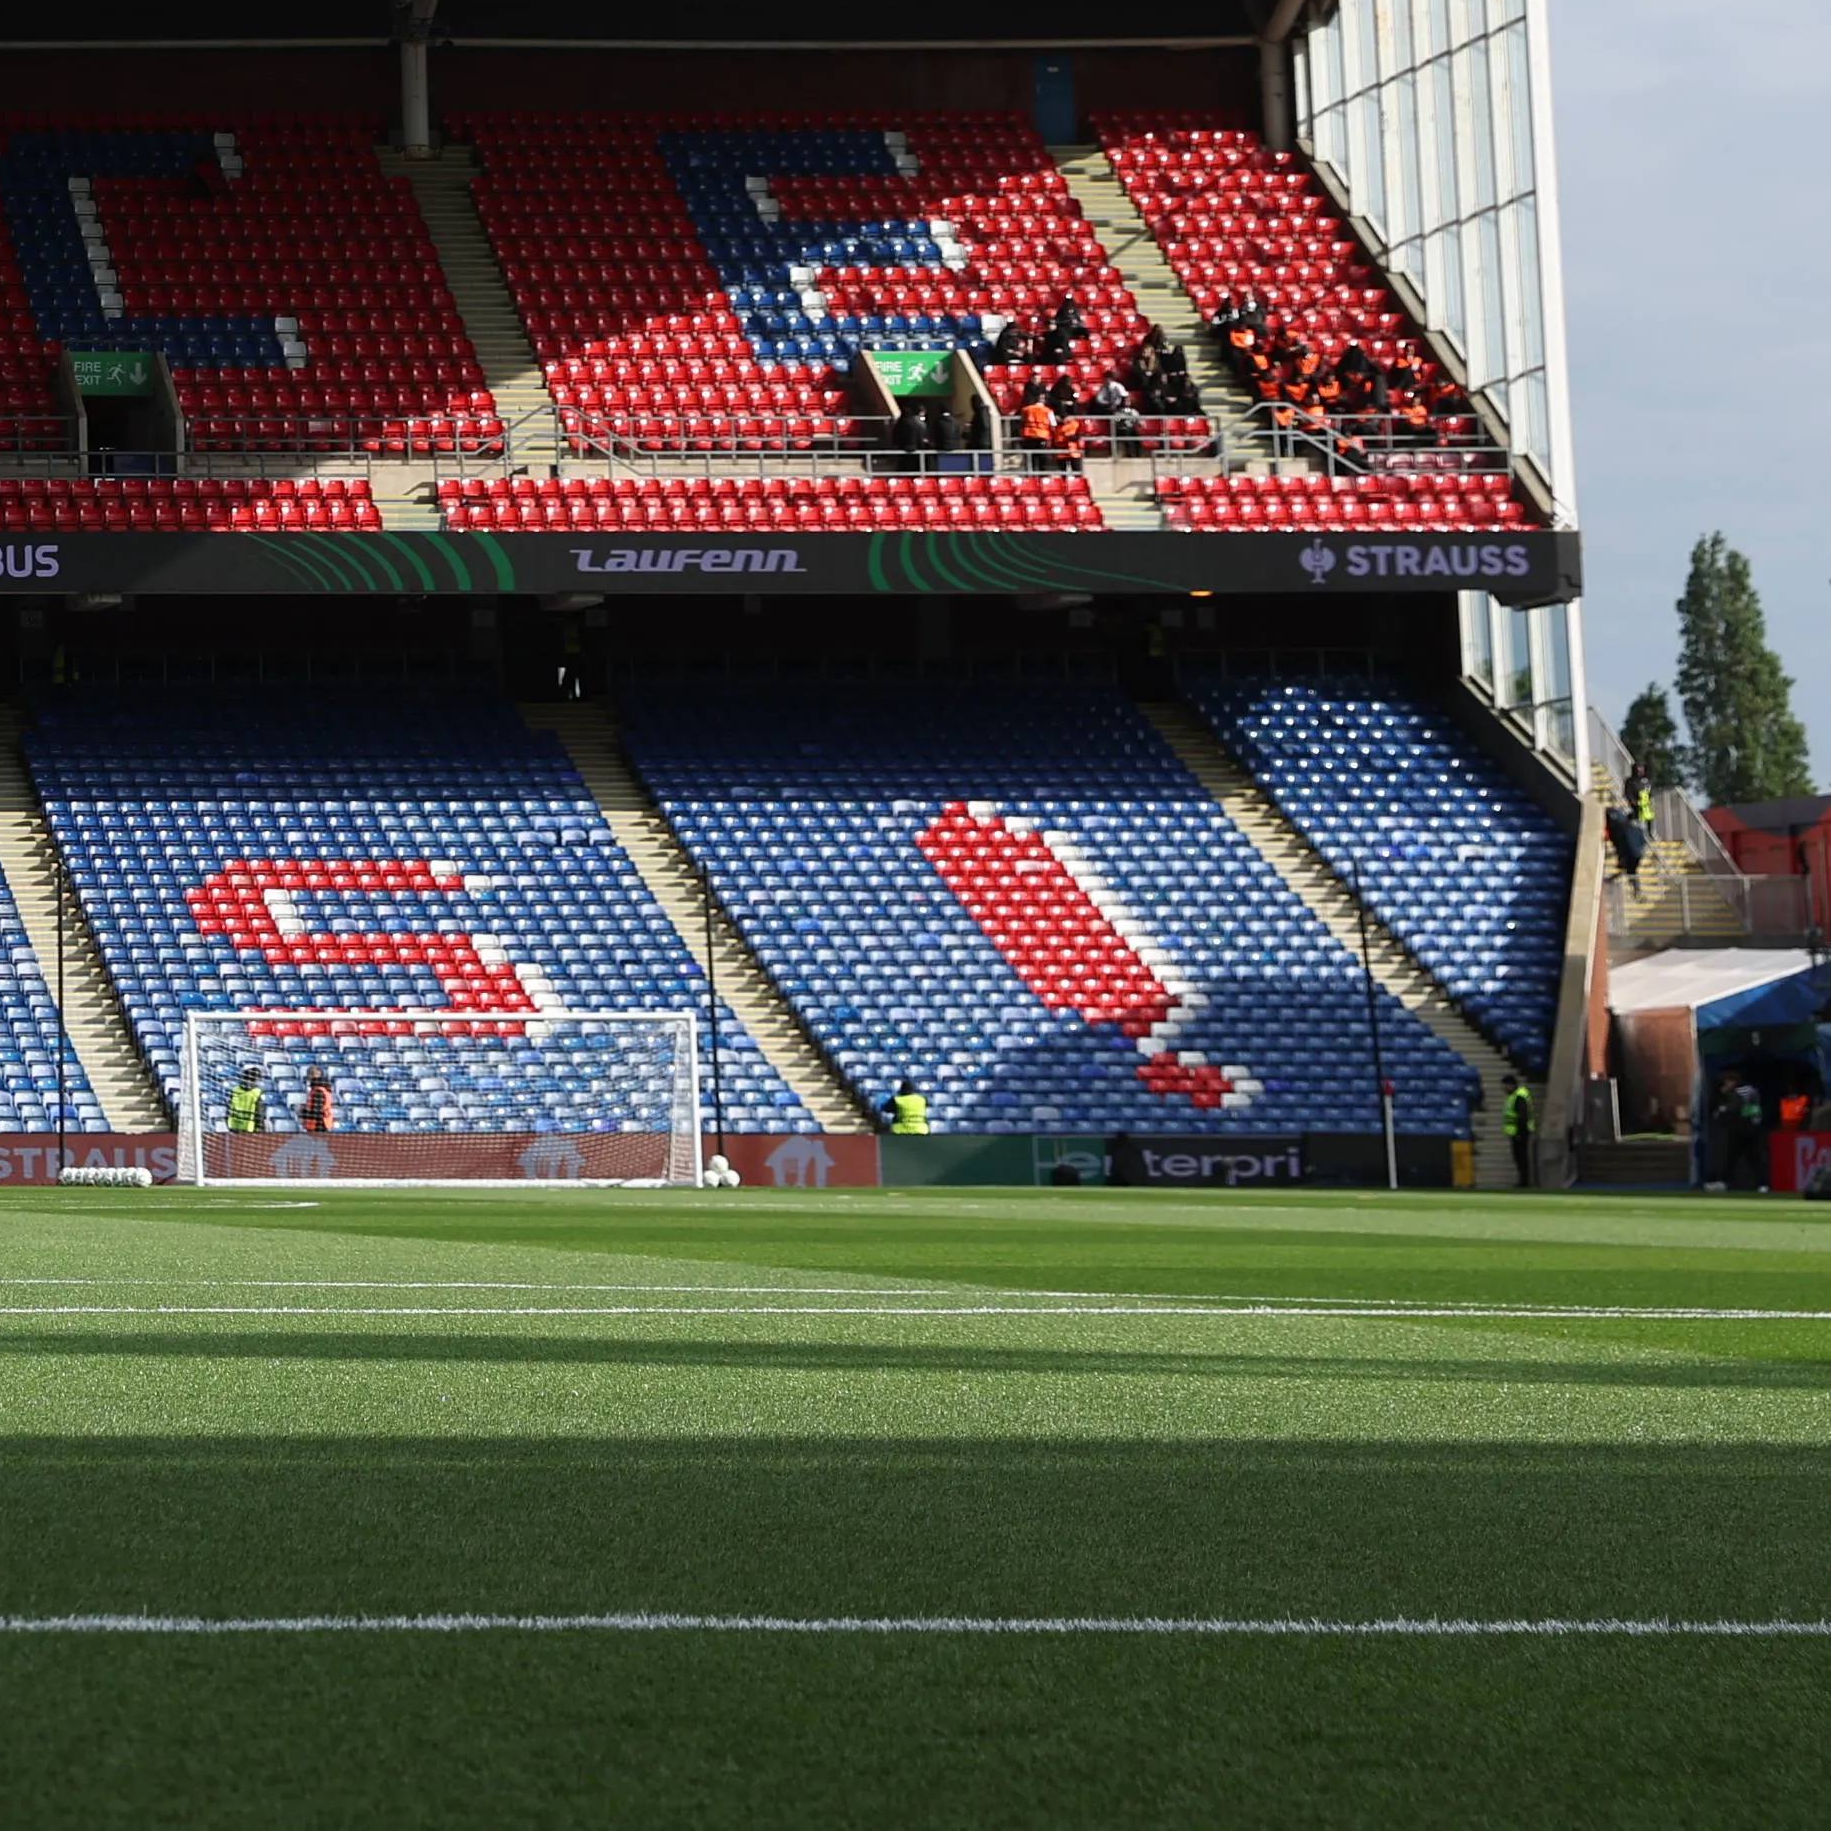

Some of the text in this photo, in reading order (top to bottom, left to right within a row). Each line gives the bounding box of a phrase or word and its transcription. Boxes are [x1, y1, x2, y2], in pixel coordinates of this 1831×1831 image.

[74, 362, 102, 373] FIRE
[74, 375, 101, 386] EXIT
[1347, 545, 1530, 577] STRAUSS
